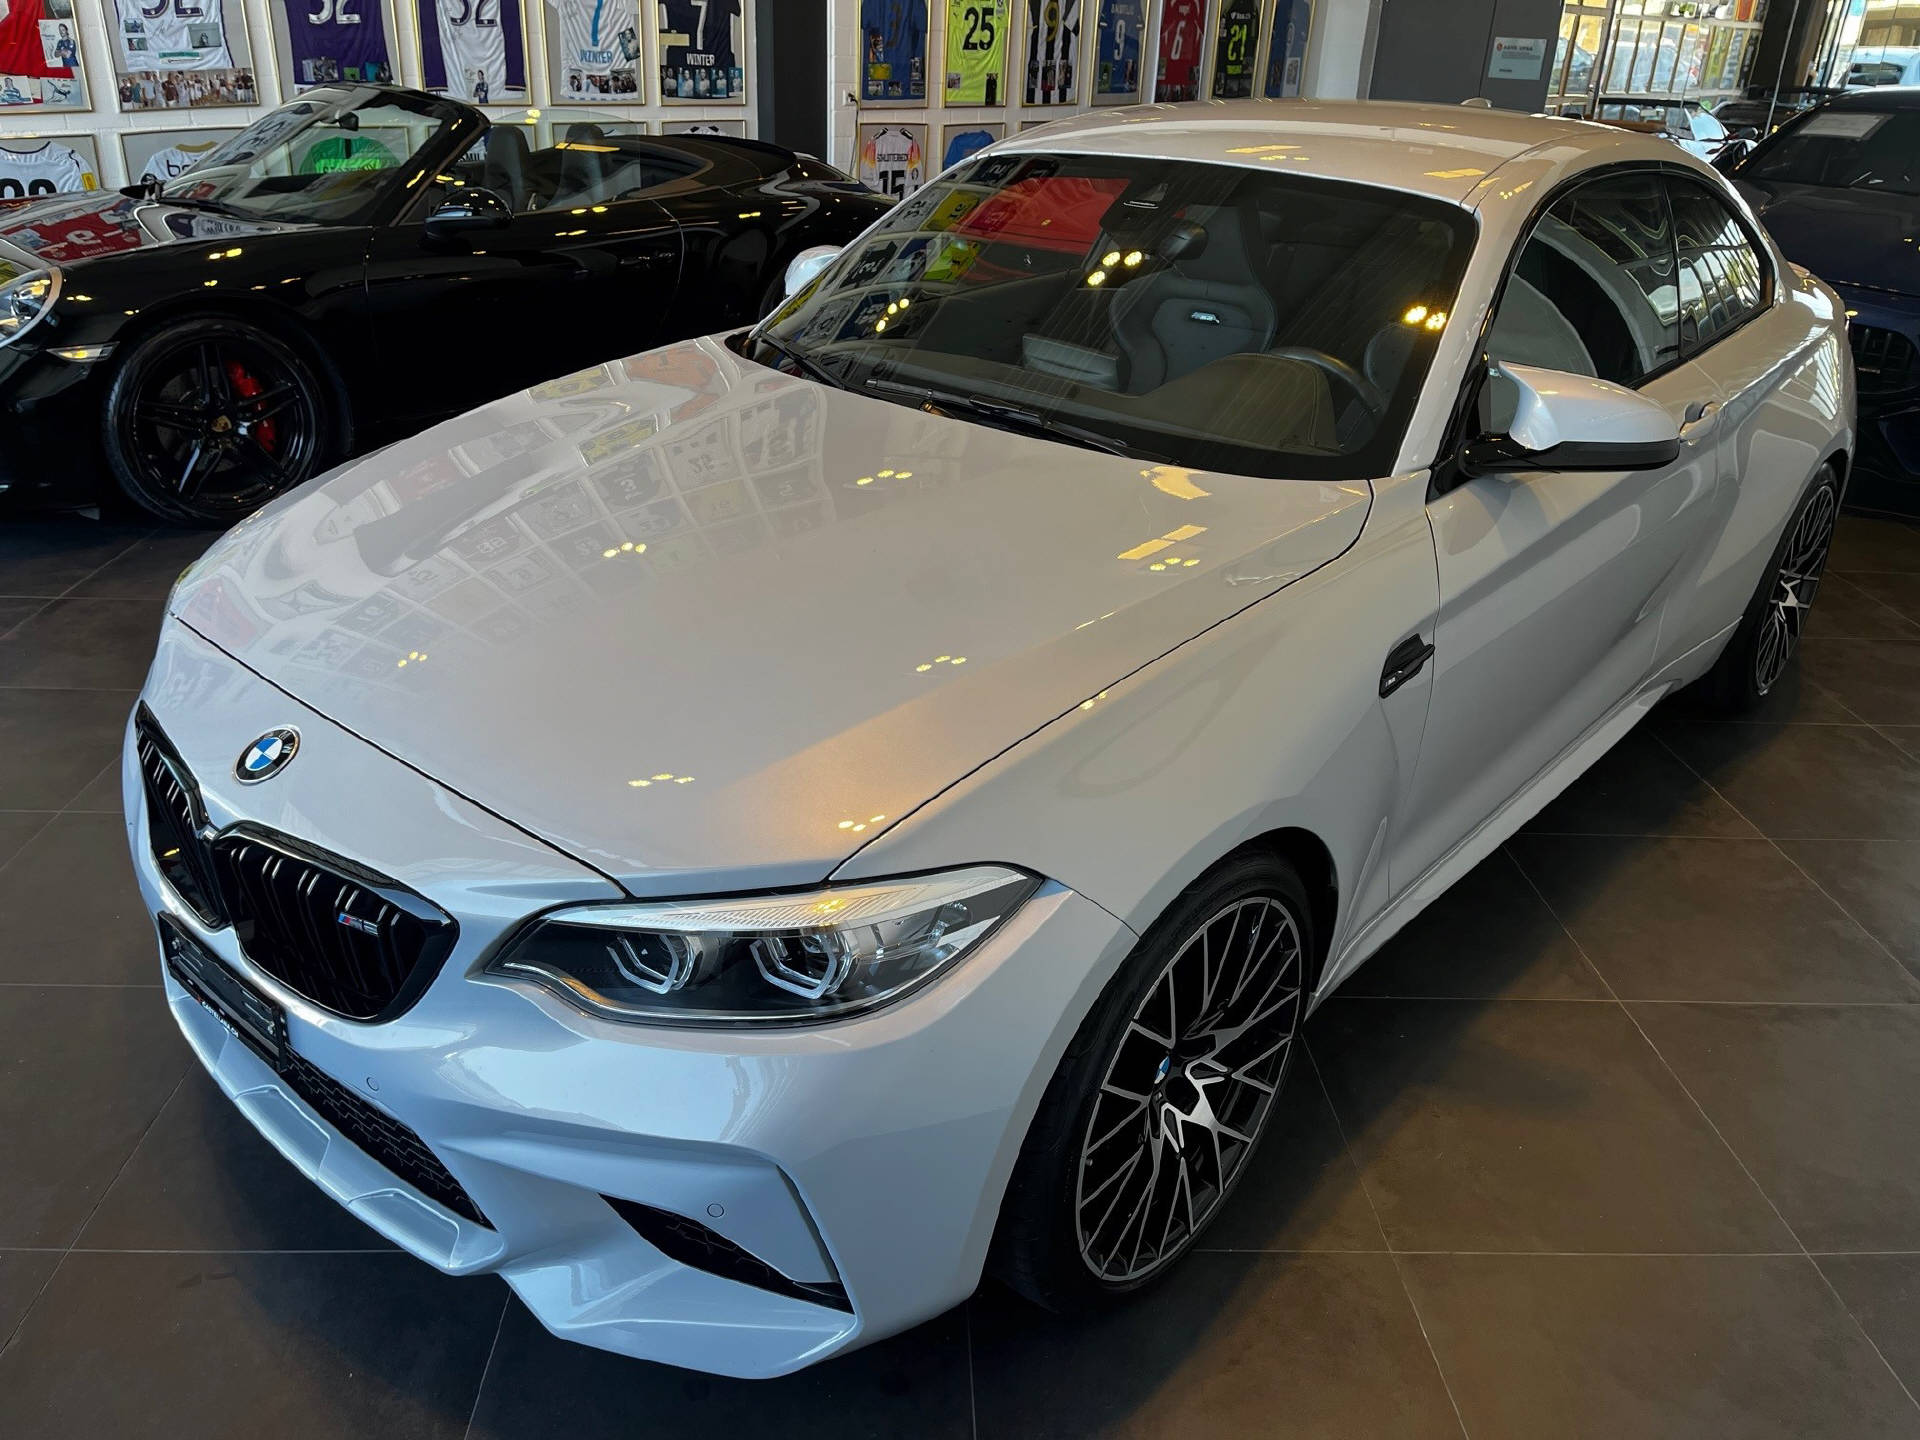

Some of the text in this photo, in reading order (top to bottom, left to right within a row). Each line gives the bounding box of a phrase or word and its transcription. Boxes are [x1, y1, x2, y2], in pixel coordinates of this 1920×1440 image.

[691, 0, 708, 50] 7
[962, 7, 995, 51] 25
[1044, 0, 1060, 42] 9
[1113, 19, 1126, 60] 9
[1170, 20, 1186, 60] 6
[580, 48, 613, 64] WINTER
[686, 52, 715, 66] WINTER
[1227, 23, 1248, 61] 21
